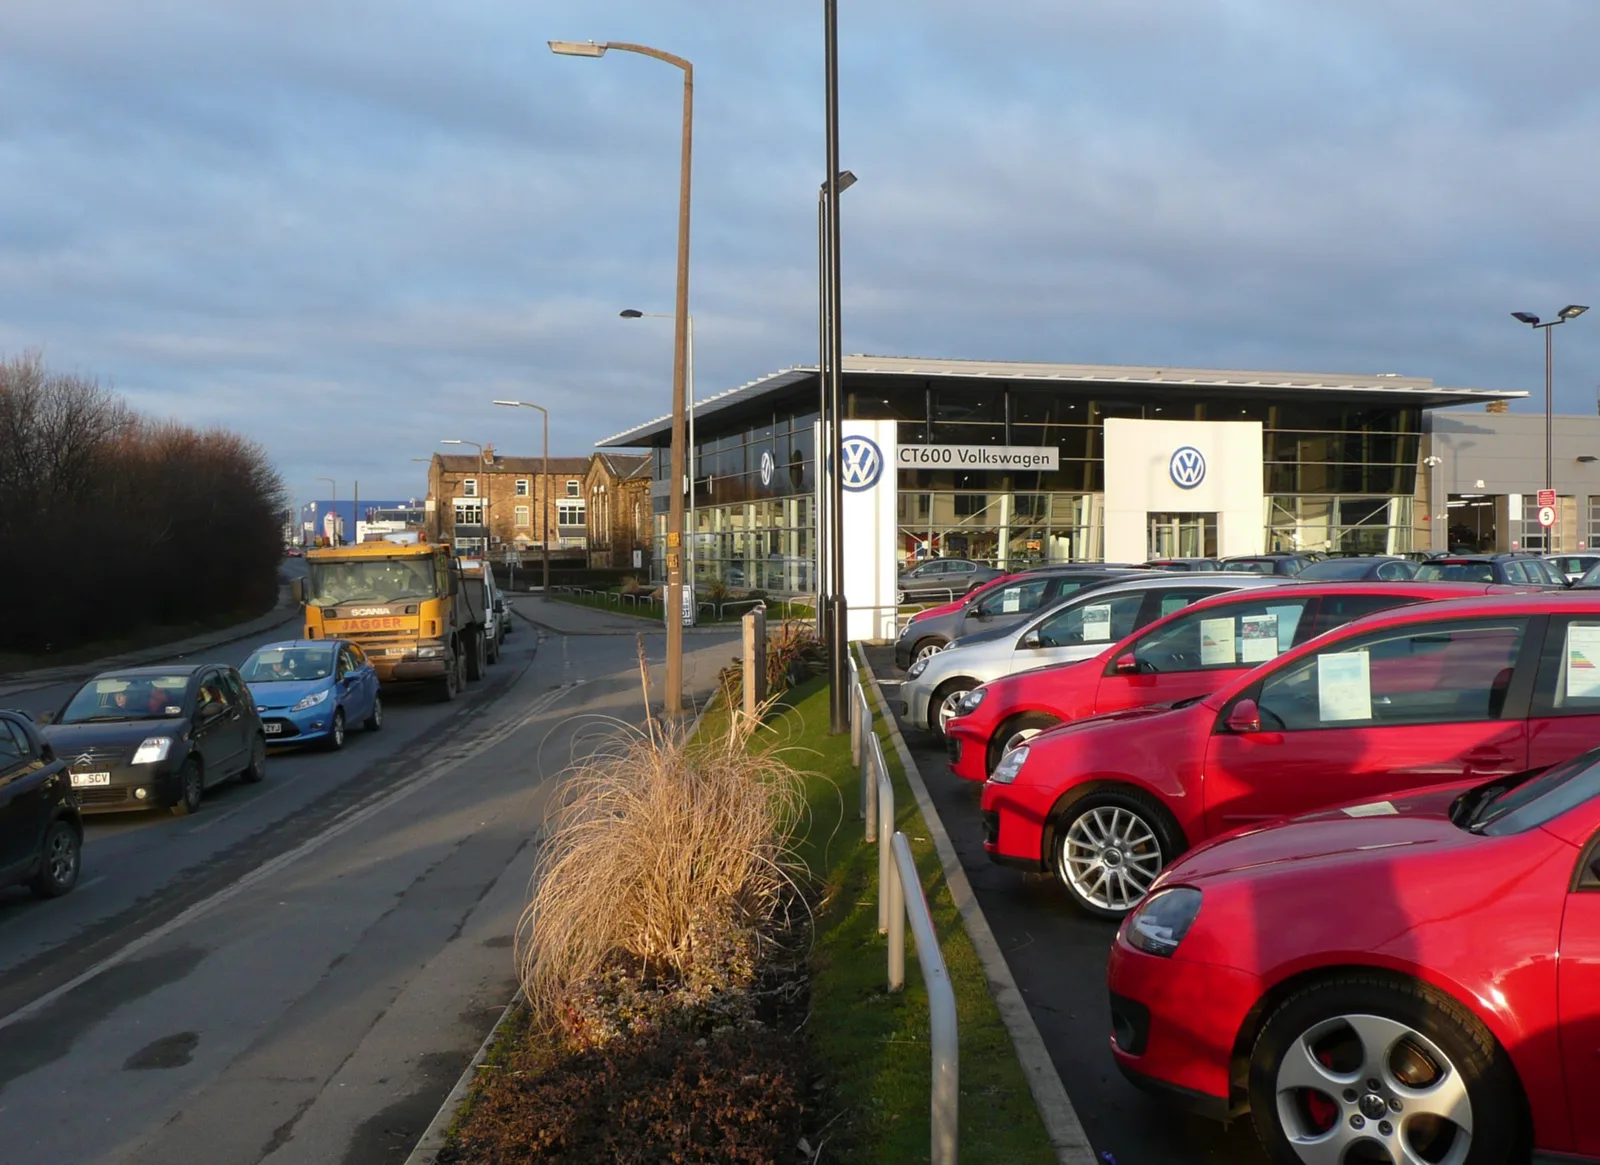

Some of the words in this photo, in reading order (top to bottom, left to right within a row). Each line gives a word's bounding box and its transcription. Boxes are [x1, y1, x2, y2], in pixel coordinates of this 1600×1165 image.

[897, 448, 952, 463] CT600
[958, 449, 1050, 467] Volkswagen
[1544, 511, 1550, 521] 5
[351, 608, 391, 617] SCANIA
[343, 618, 402, 630] JAGGER
[88, 773, 107, 783] SCV
